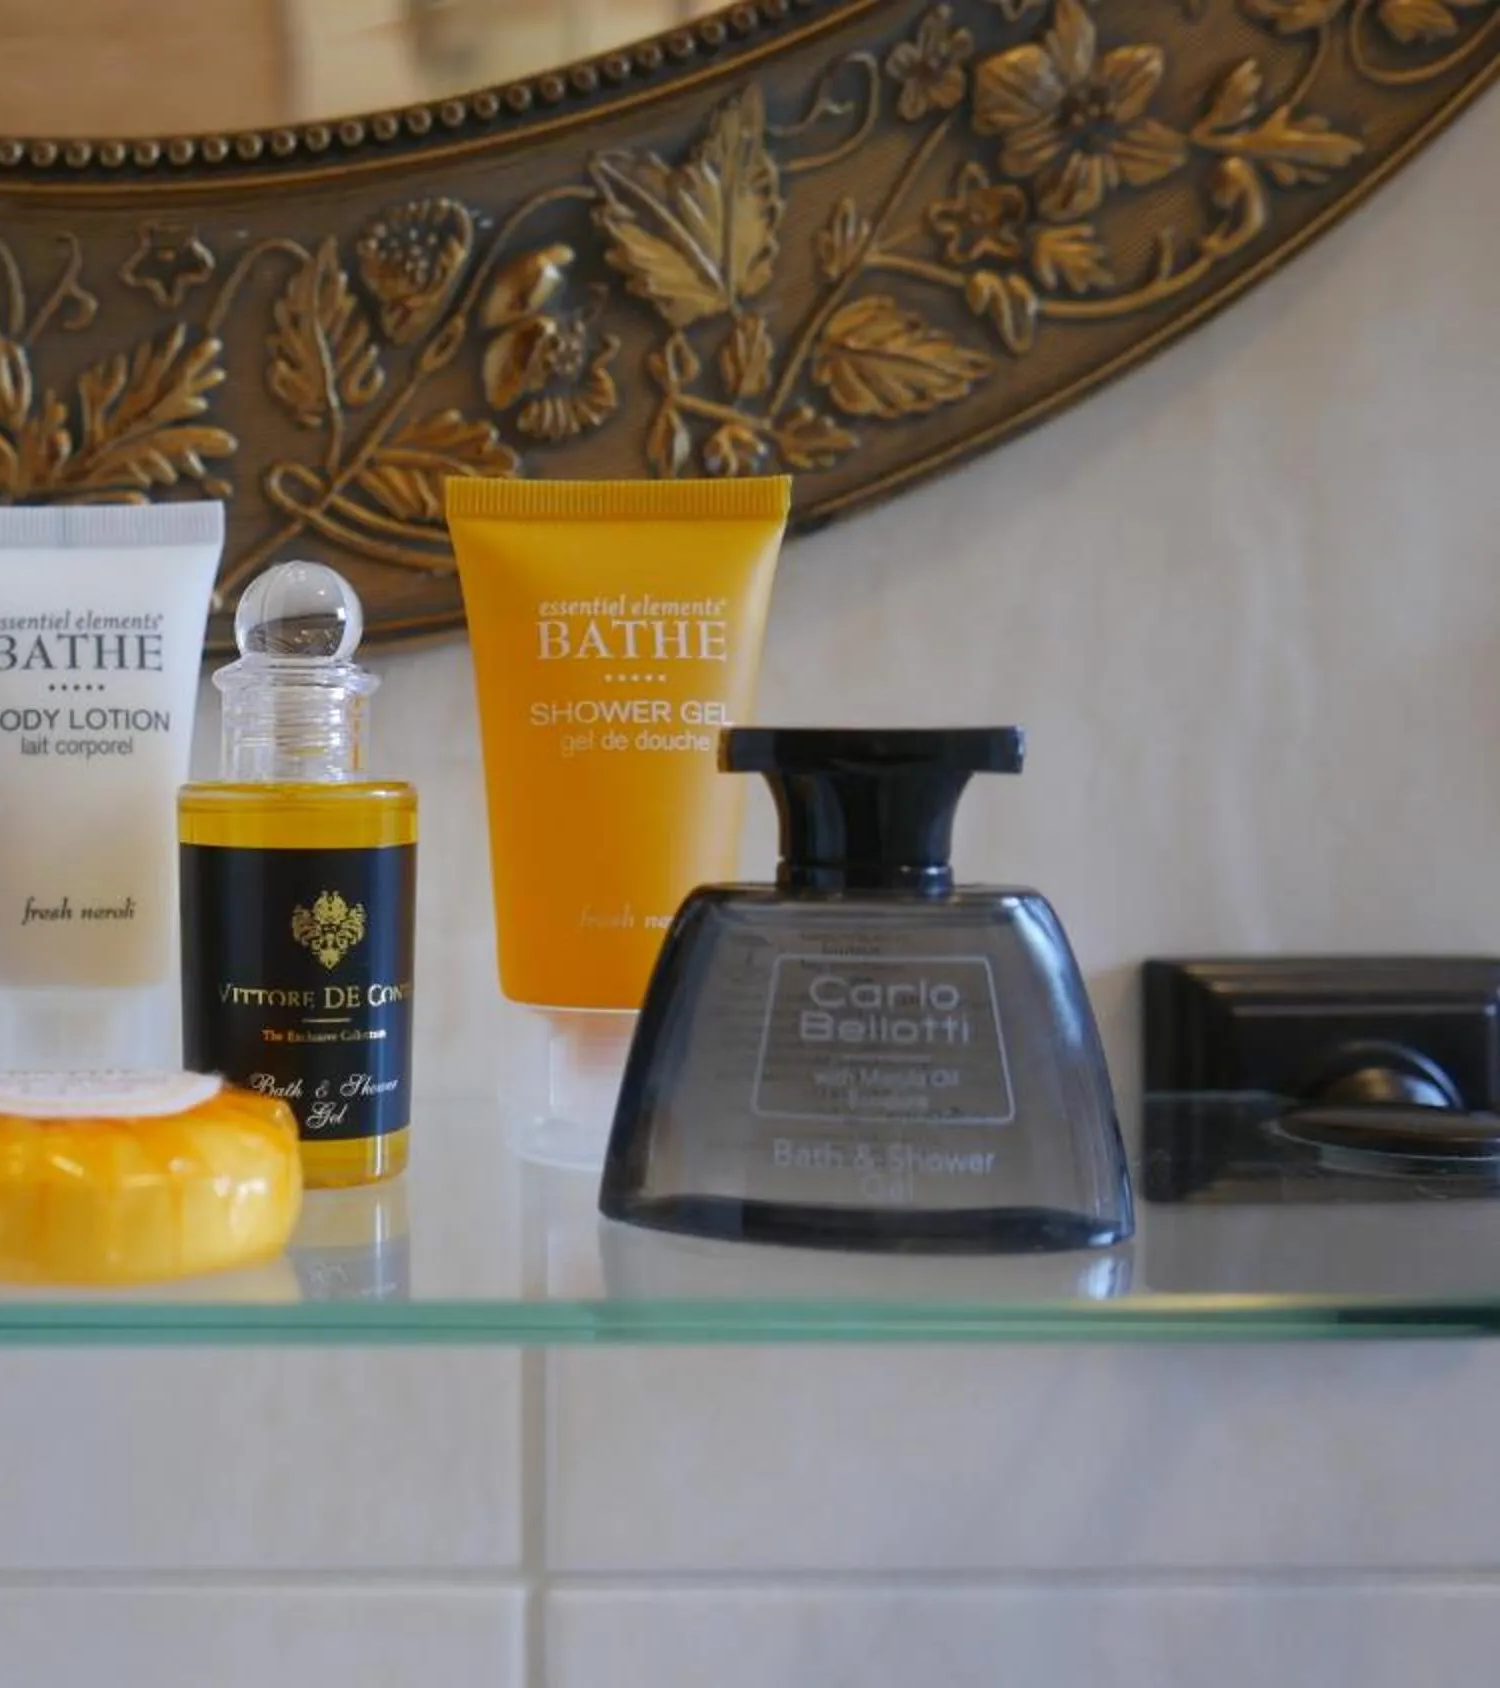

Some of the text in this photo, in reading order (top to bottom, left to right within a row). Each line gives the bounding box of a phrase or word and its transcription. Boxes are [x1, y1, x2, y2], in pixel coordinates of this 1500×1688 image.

[539, 594, 625, 617] essentiel
[537, 620, 728, 662] BATHE
[69, 708, 171, 732] LOTION
[530, 700, 735, 727] SHOWER GEL
[20, 737, 134, 760] lait corporel
[560, 729, 712, 758] gel de douche
[21, 897, 136, 926] fresh neroli
[324, 986, 362, 1010] DE
[808, 976, 961, 1013] Carlo
[800, 1010, 971, 1044] Bellotti
[306, 1101, 349, 1130] Gel
[773, 1138, 843, 1168] Bath
